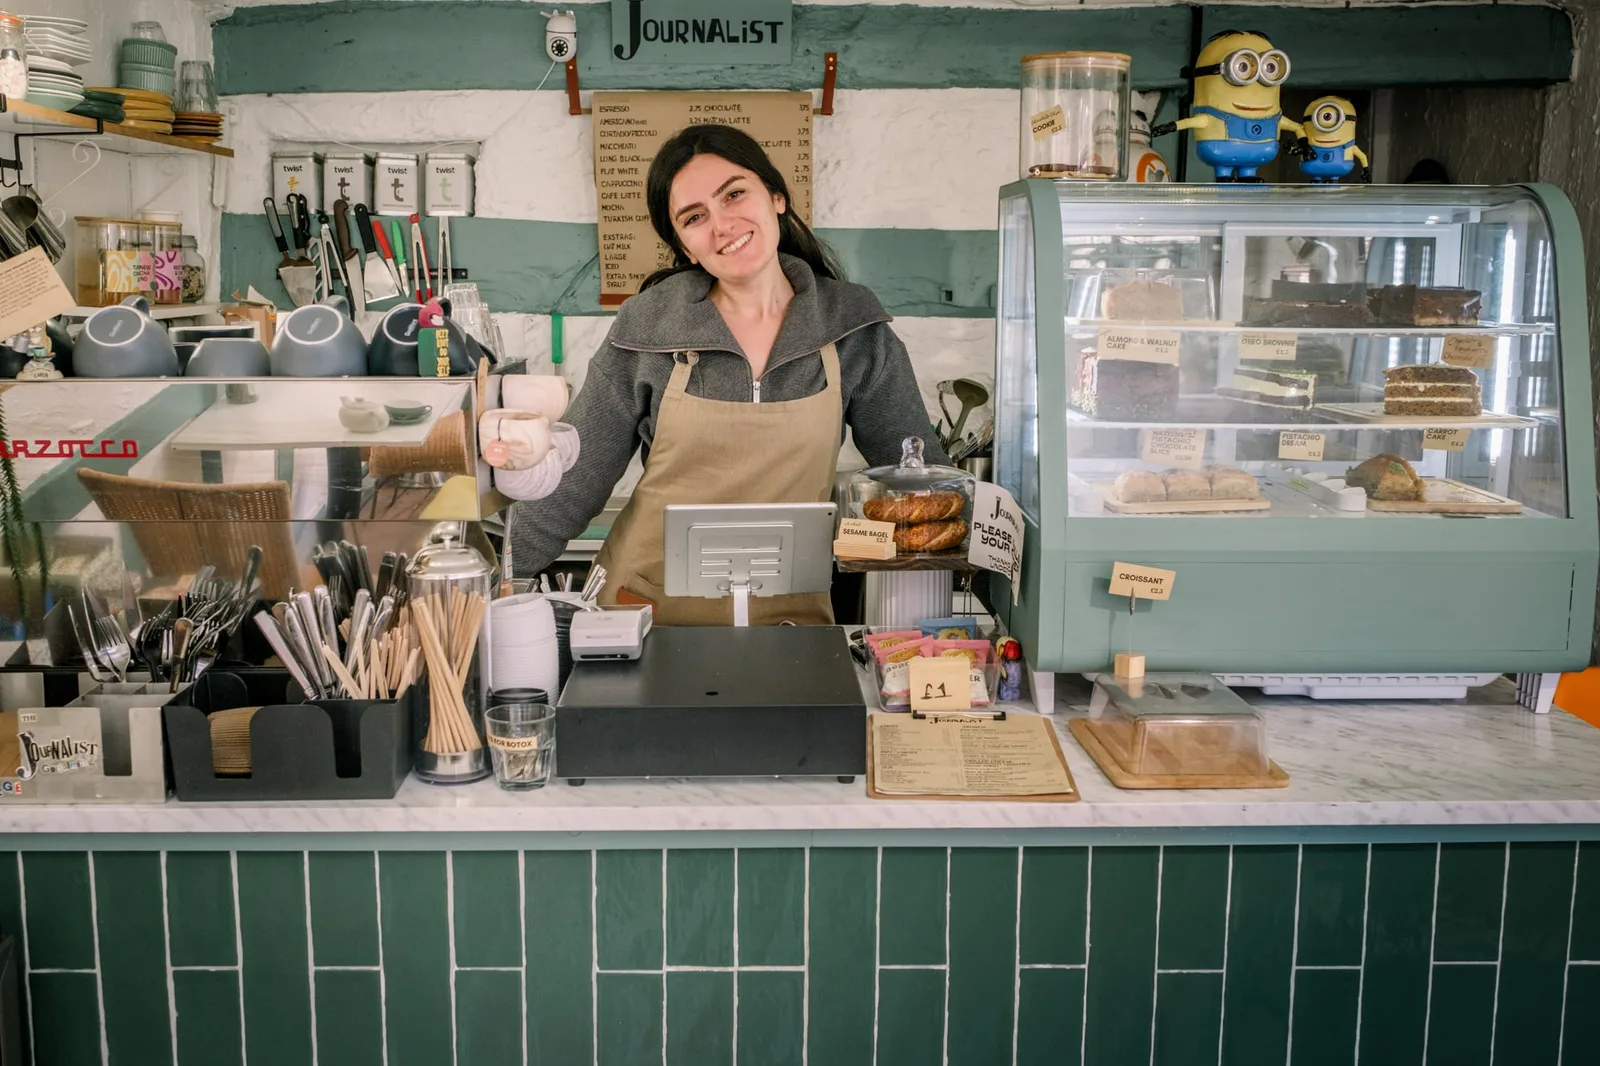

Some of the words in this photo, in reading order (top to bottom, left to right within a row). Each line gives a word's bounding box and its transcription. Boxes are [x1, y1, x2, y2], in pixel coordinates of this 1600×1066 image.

[599, 105, 630, 113] ESPRESSO
[704, 104, 741, 112] CHOCOLATE
[1032, 119, 1055, 133] COOKIE
[772, 140, 792, 148] LATTE
[600, 155, 617, 163] LONG
[436, 166, 456, 174] twist
[601, 180, 643, 188] CAPPUCCINO
[603, 215, 633, 223] TURKISH
[1107, 335, 1138, 344] ALMOND
[1147, 338, 1177, 347] WALNUT
[1263, 339, 1296, 347] BROWNIE
[1106, 342, 1127, 350] CAKE
[1151, 436, 1191, 444] PISTACHIO
[1282, 433, 1321, 441] PISTACHIO
[1150, 442, 1196, 451] CHOCOLATE
[843, 528, 868, 536] SESAME
[869, 530, 888, 538] BAGEL
[974, 522, 1012, 544] PLEASE
[981, 534, 1011, 553] YOUR
[1119, 573, 1164, 585] CROISSANT
[920, 682, 952, 700] £1
[493, 738, 505, 746] FOR
[506, 740, 532, 748] BOTOX
[15, 731, 98, 780] JOURNALIST
